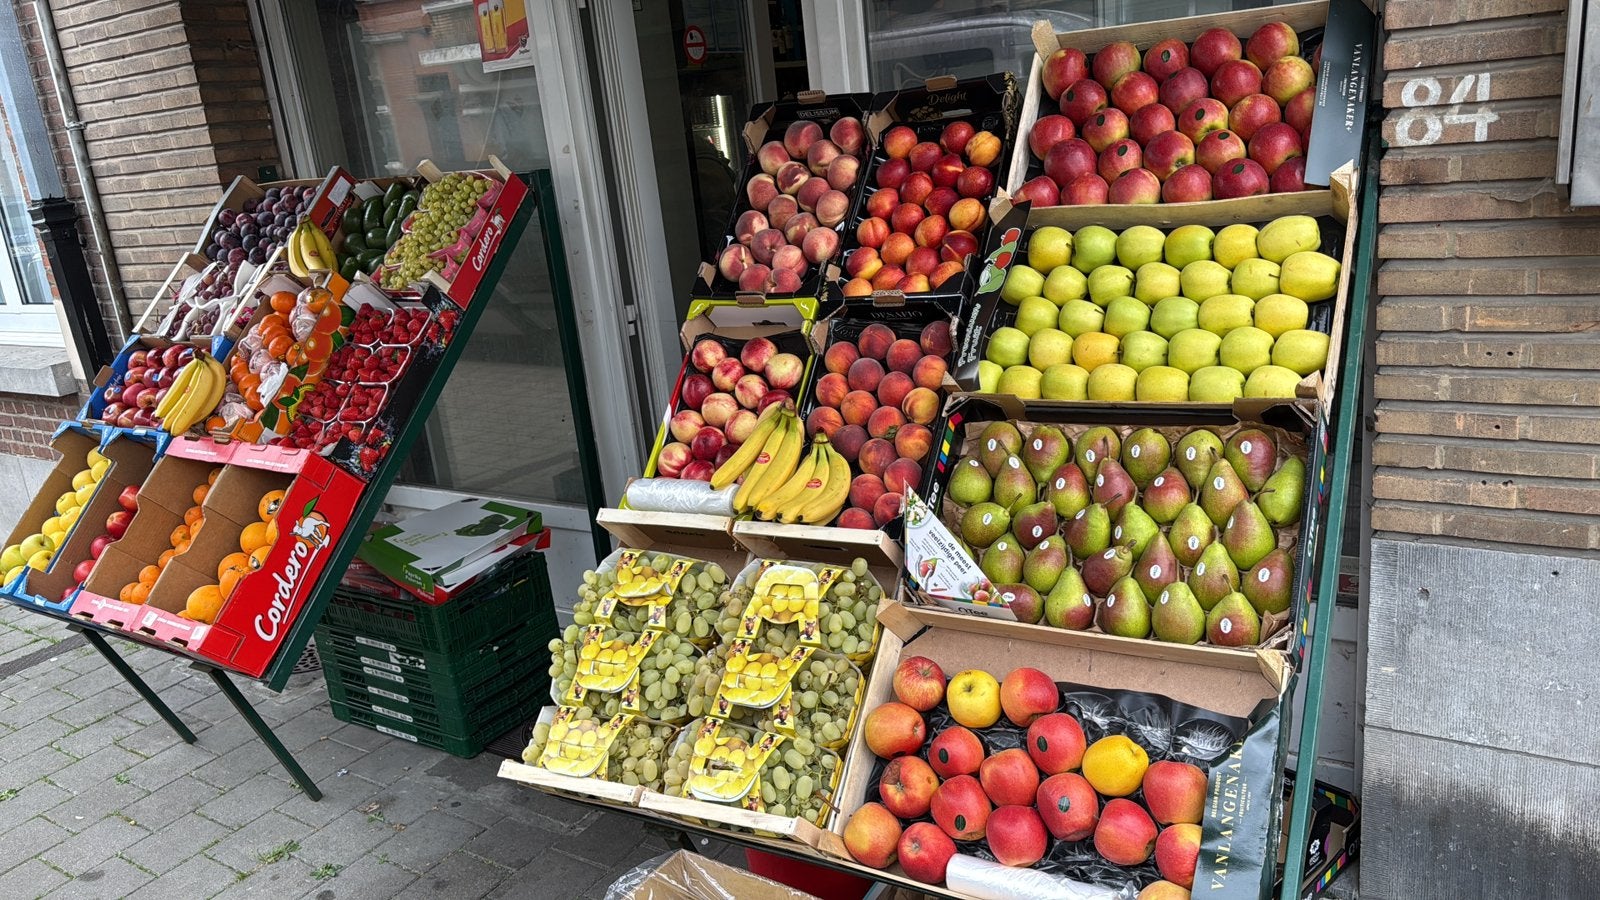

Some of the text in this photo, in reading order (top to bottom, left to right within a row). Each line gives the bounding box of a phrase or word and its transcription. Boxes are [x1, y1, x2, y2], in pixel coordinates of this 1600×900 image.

[927, 90, 968, 106] Delight
[1396, 72, 1499, 146] 84
[471, 226, 495, 272] Cordero
[927, 480, 940, 509] Tee
[929, 530, 955, 562] veelzijdige
[954, 561, 968, 575] peer
[948, 542, 956, 551] de
[955, 551, 972, 570] meest
[254, 541, 309, 642] Cordero
